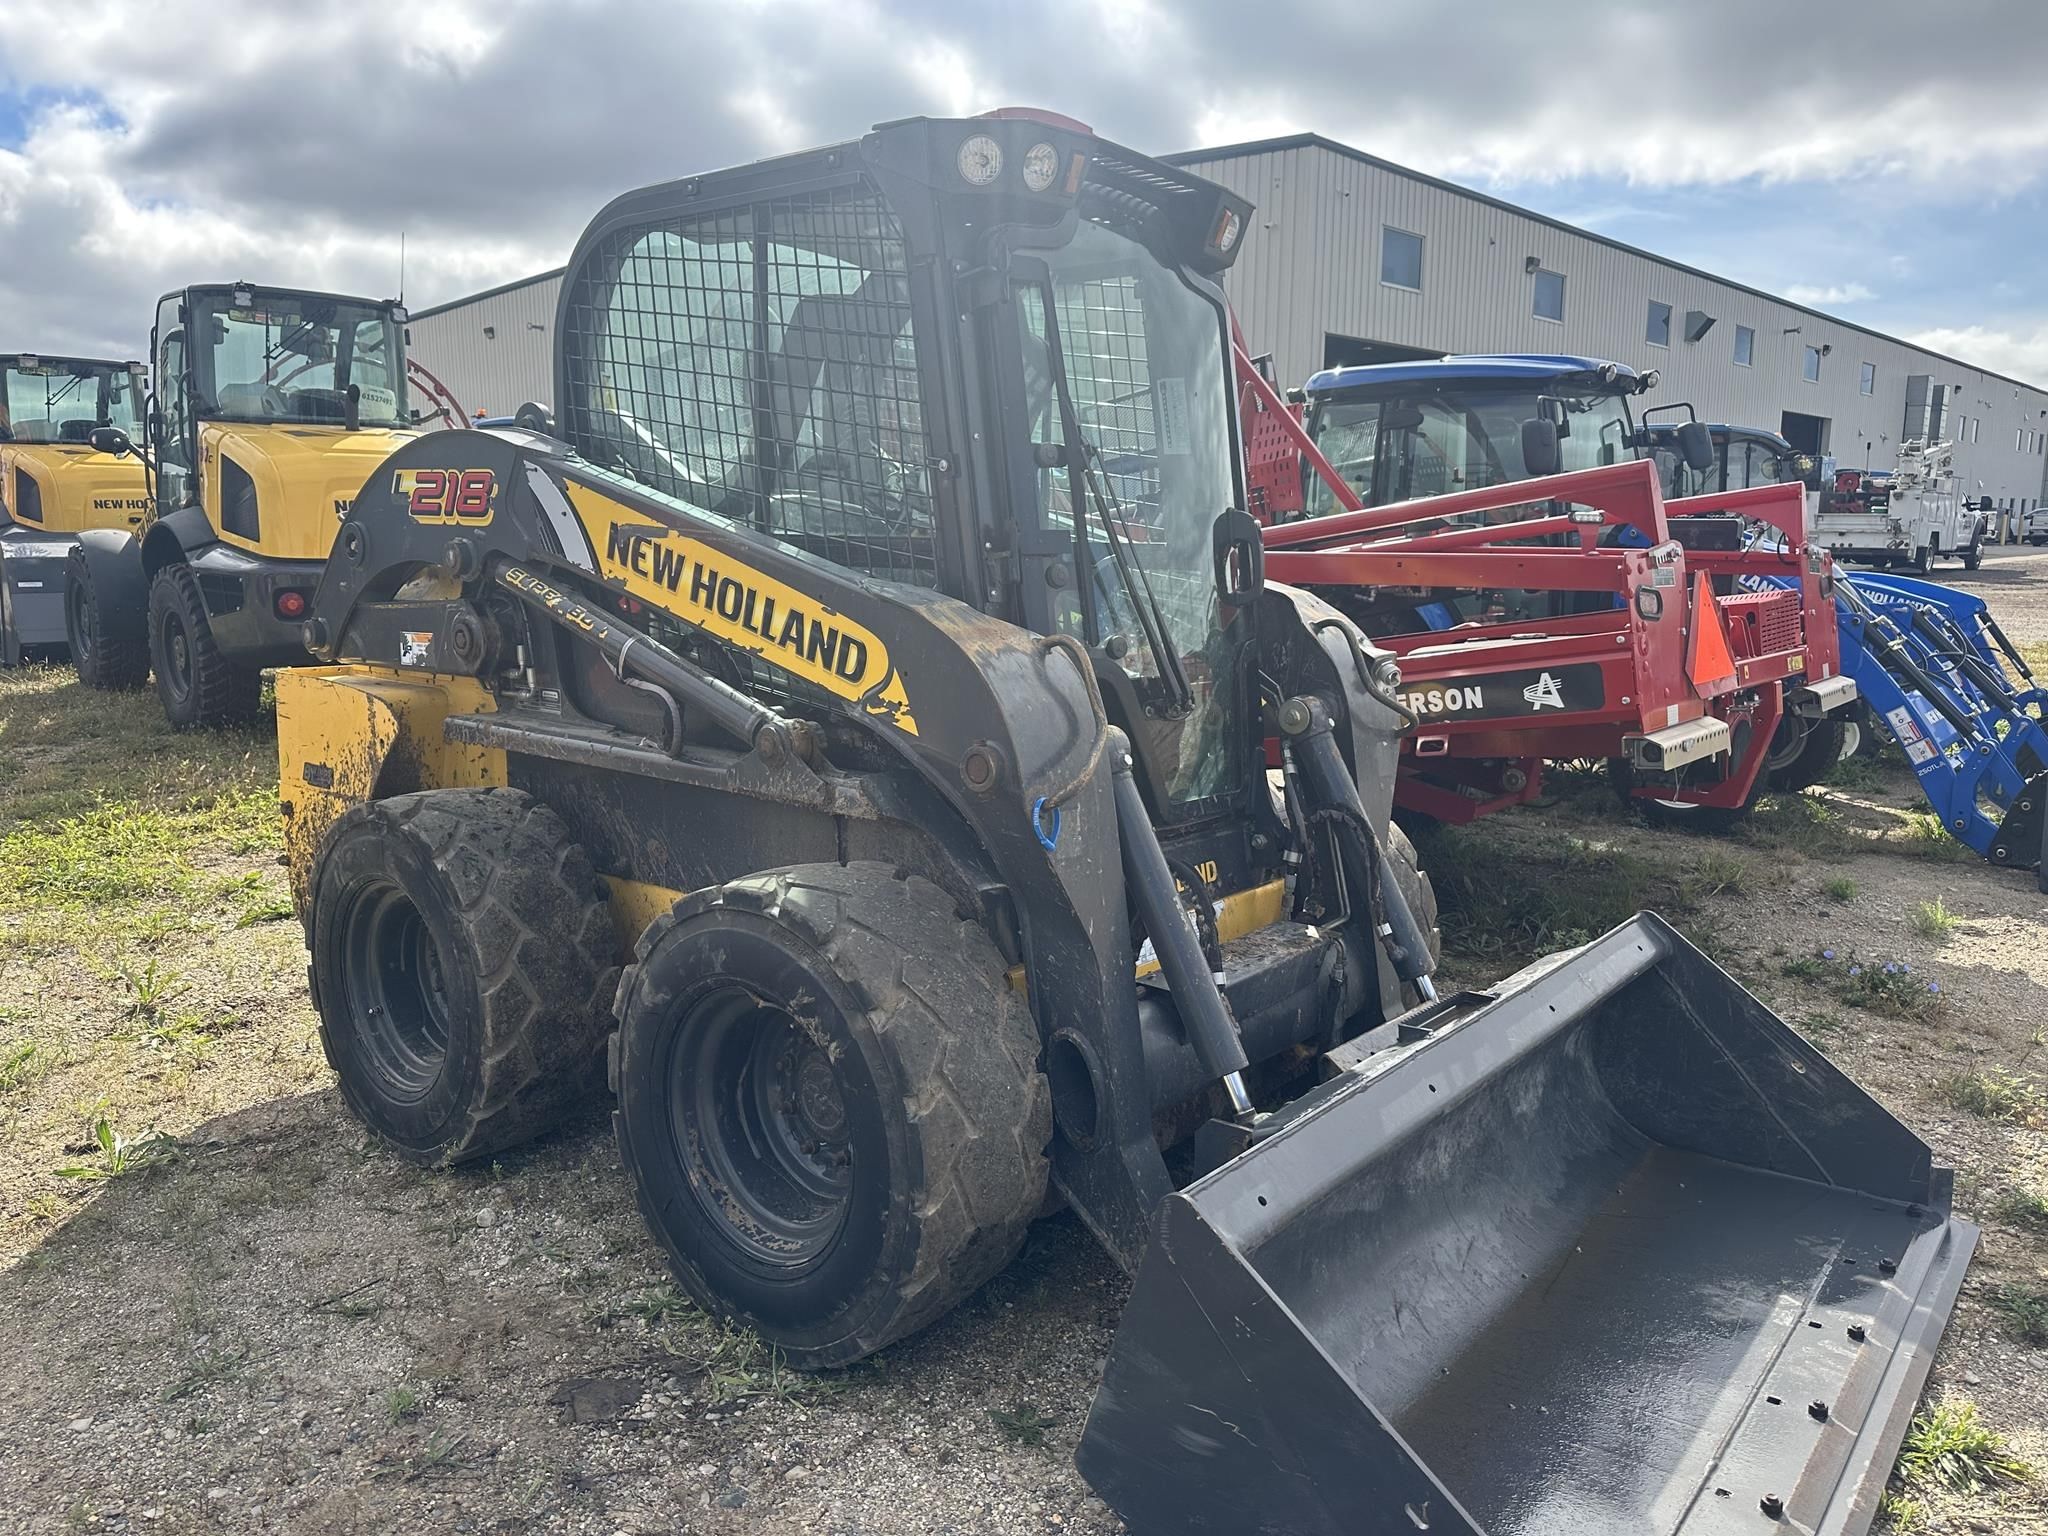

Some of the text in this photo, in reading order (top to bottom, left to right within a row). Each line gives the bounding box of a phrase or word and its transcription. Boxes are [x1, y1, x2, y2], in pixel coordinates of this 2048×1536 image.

[94, 499, 123, 509] NEW
[1739, 574, 1782, 593] LAN
[606, 520, 868, 685] NEW HOLLAND
